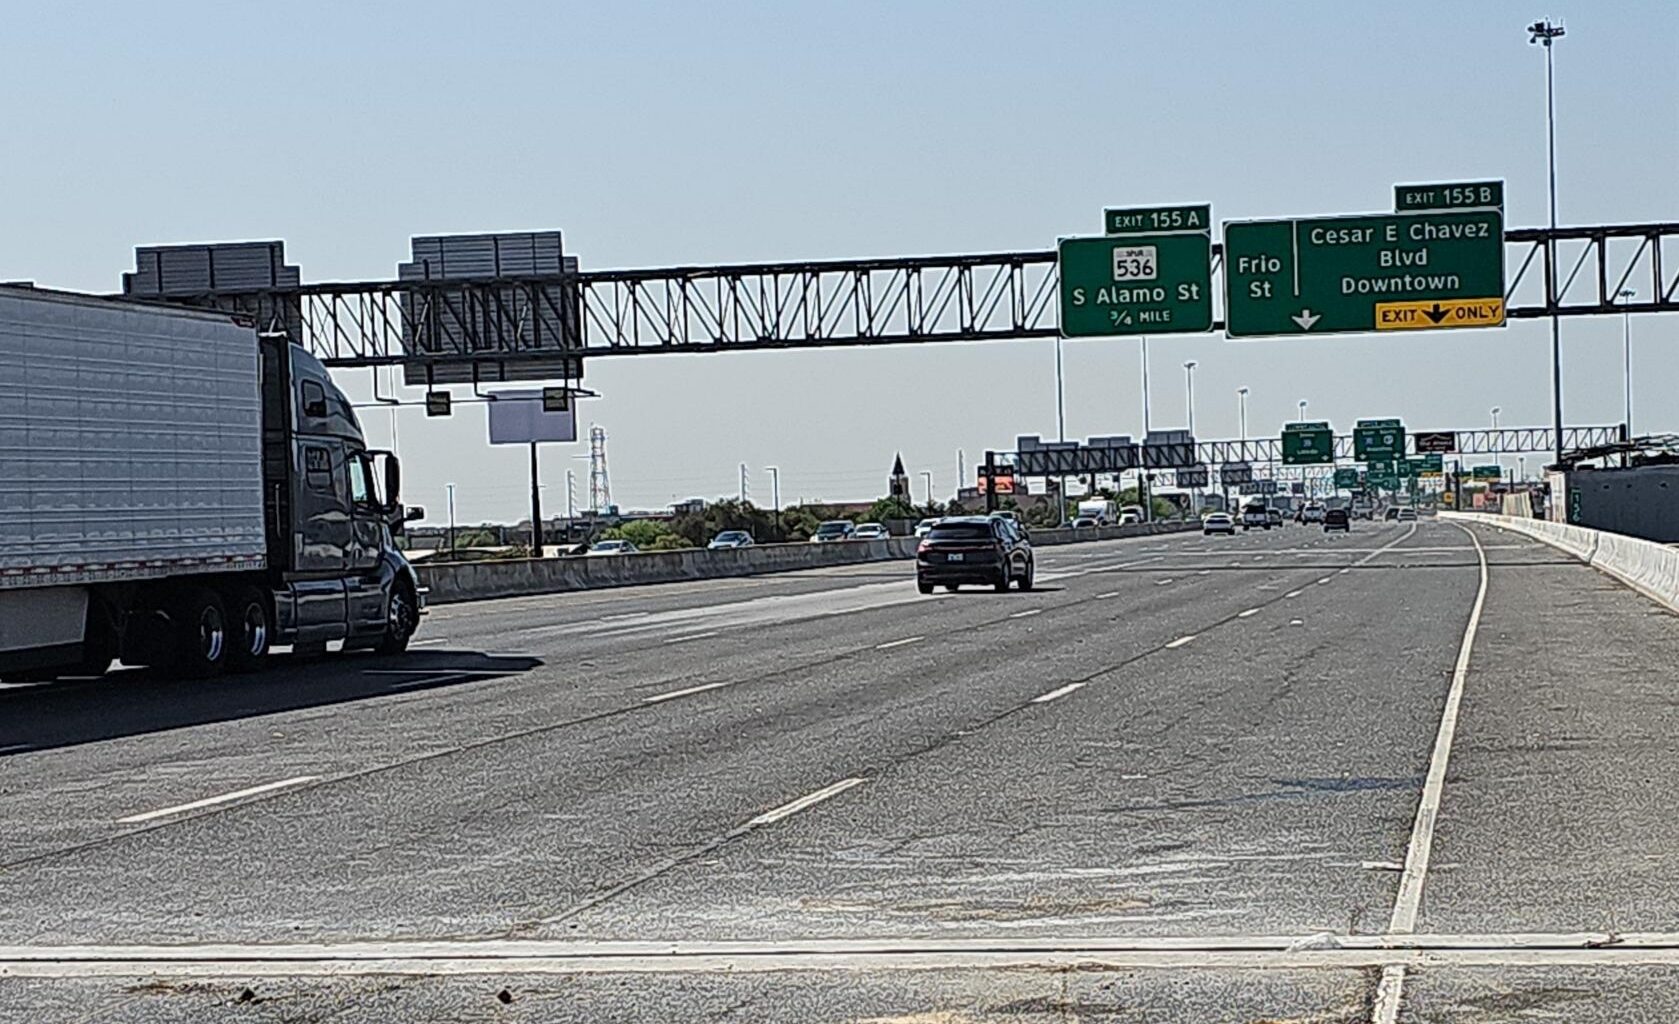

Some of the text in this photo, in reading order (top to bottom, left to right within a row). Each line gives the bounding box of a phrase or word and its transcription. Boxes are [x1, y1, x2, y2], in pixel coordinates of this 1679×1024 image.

[1406, 187, 1491, 205] EXIT 155 B
[1115, 211, 1200, 227] EXIT 155 A
[1311, 222, 1489, 244] Cesar E Chavez
[1239, 255, 1281, 273] Frio
[1380, 248, 1427, 267] Blvd
[1117, 259, 1154, 277] 536
[1250, 281, 1271, 297] St
[1341, 274, 1459, 294] Downtown
[1073, 282, 1200, 305] S Alamo St
[1139, 310, 1171, 323] MILE
[1382, 305, 1500, 323] EXIT ONLY
